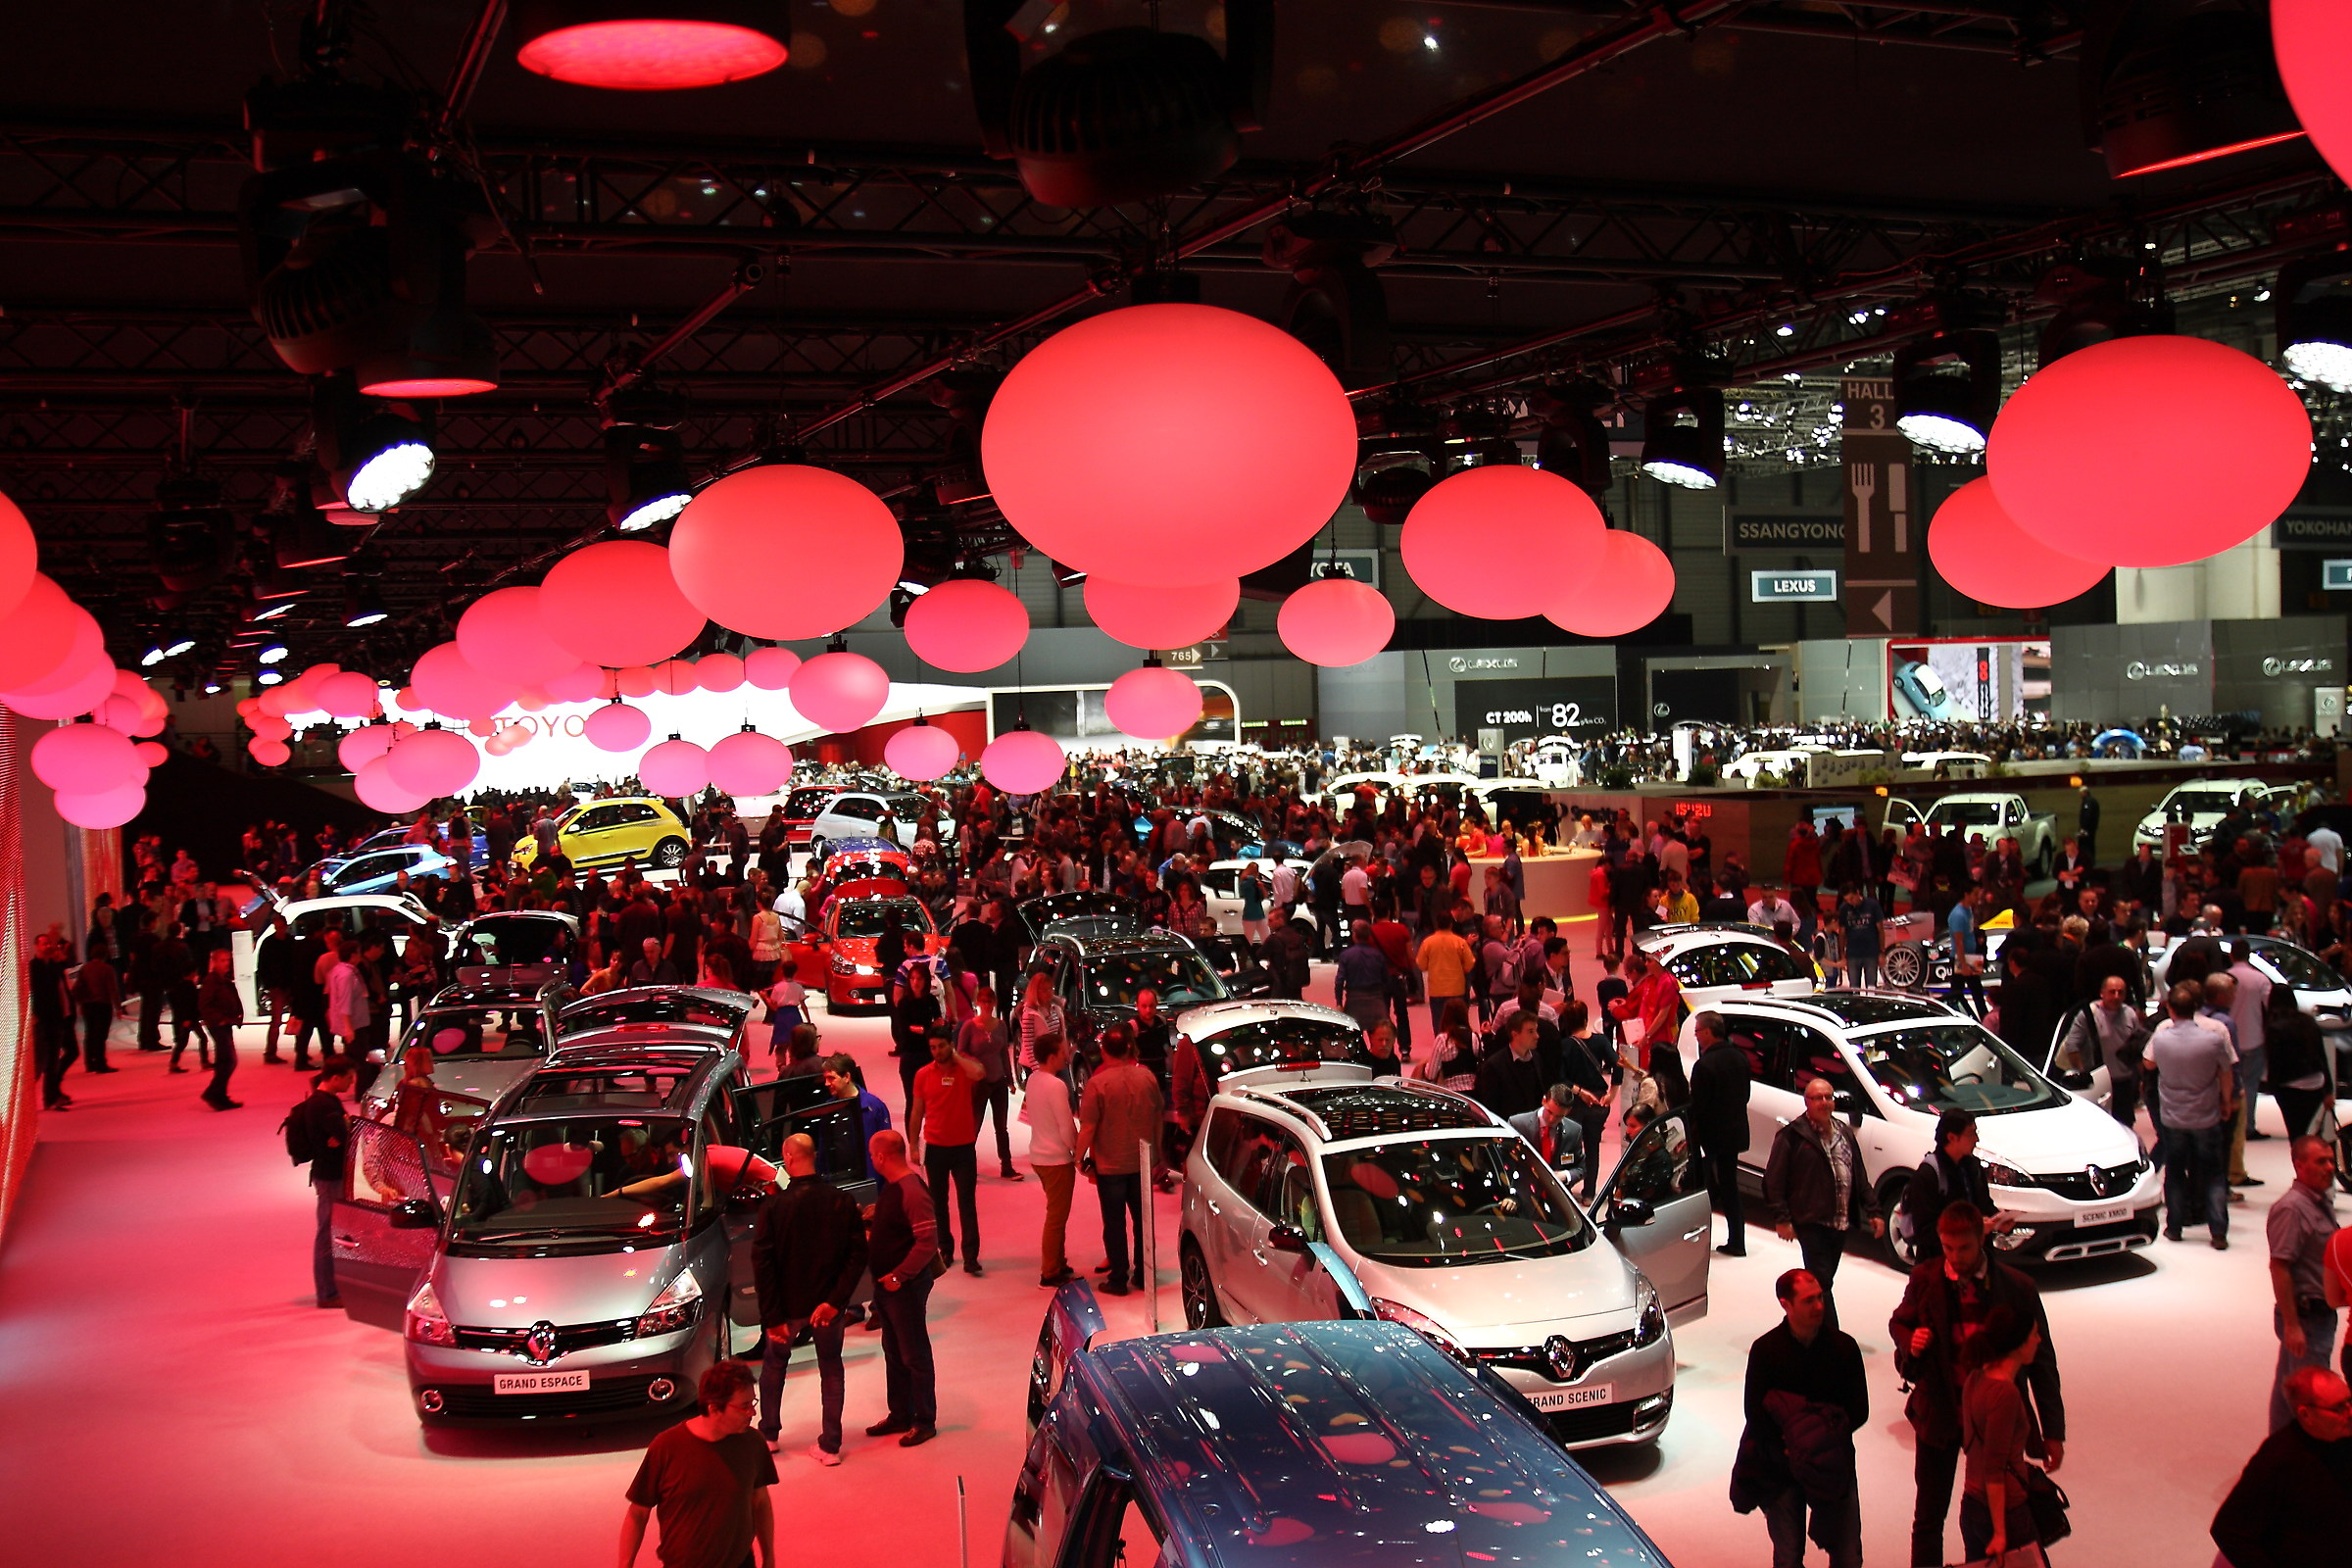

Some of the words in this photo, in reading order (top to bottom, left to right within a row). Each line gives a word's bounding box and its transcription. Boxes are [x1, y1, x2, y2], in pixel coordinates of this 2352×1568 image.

[1847, 382, 1894, 400] HALL
[1870, 404, 1886, 431] 3
[1774, 579, 1817, 593] LEXUS
[1171, 651, 1192, 662] 765
[2145, 663, 2199, 676] LEXUS
[1486, 710, 1501, 724] CT
[1502, 710, 1533, 723] 200h
[1551, 702, 1581, 728] 82
[493, 714, 586, 737] TOYO
[499, 1378, 537, 1390] GRAND
[541, 1375, 583, 1389] ESPACE
[1528, 1395, 1564, 1408] RAND
[1568, 1389, 1607, 1404] SCENIC
